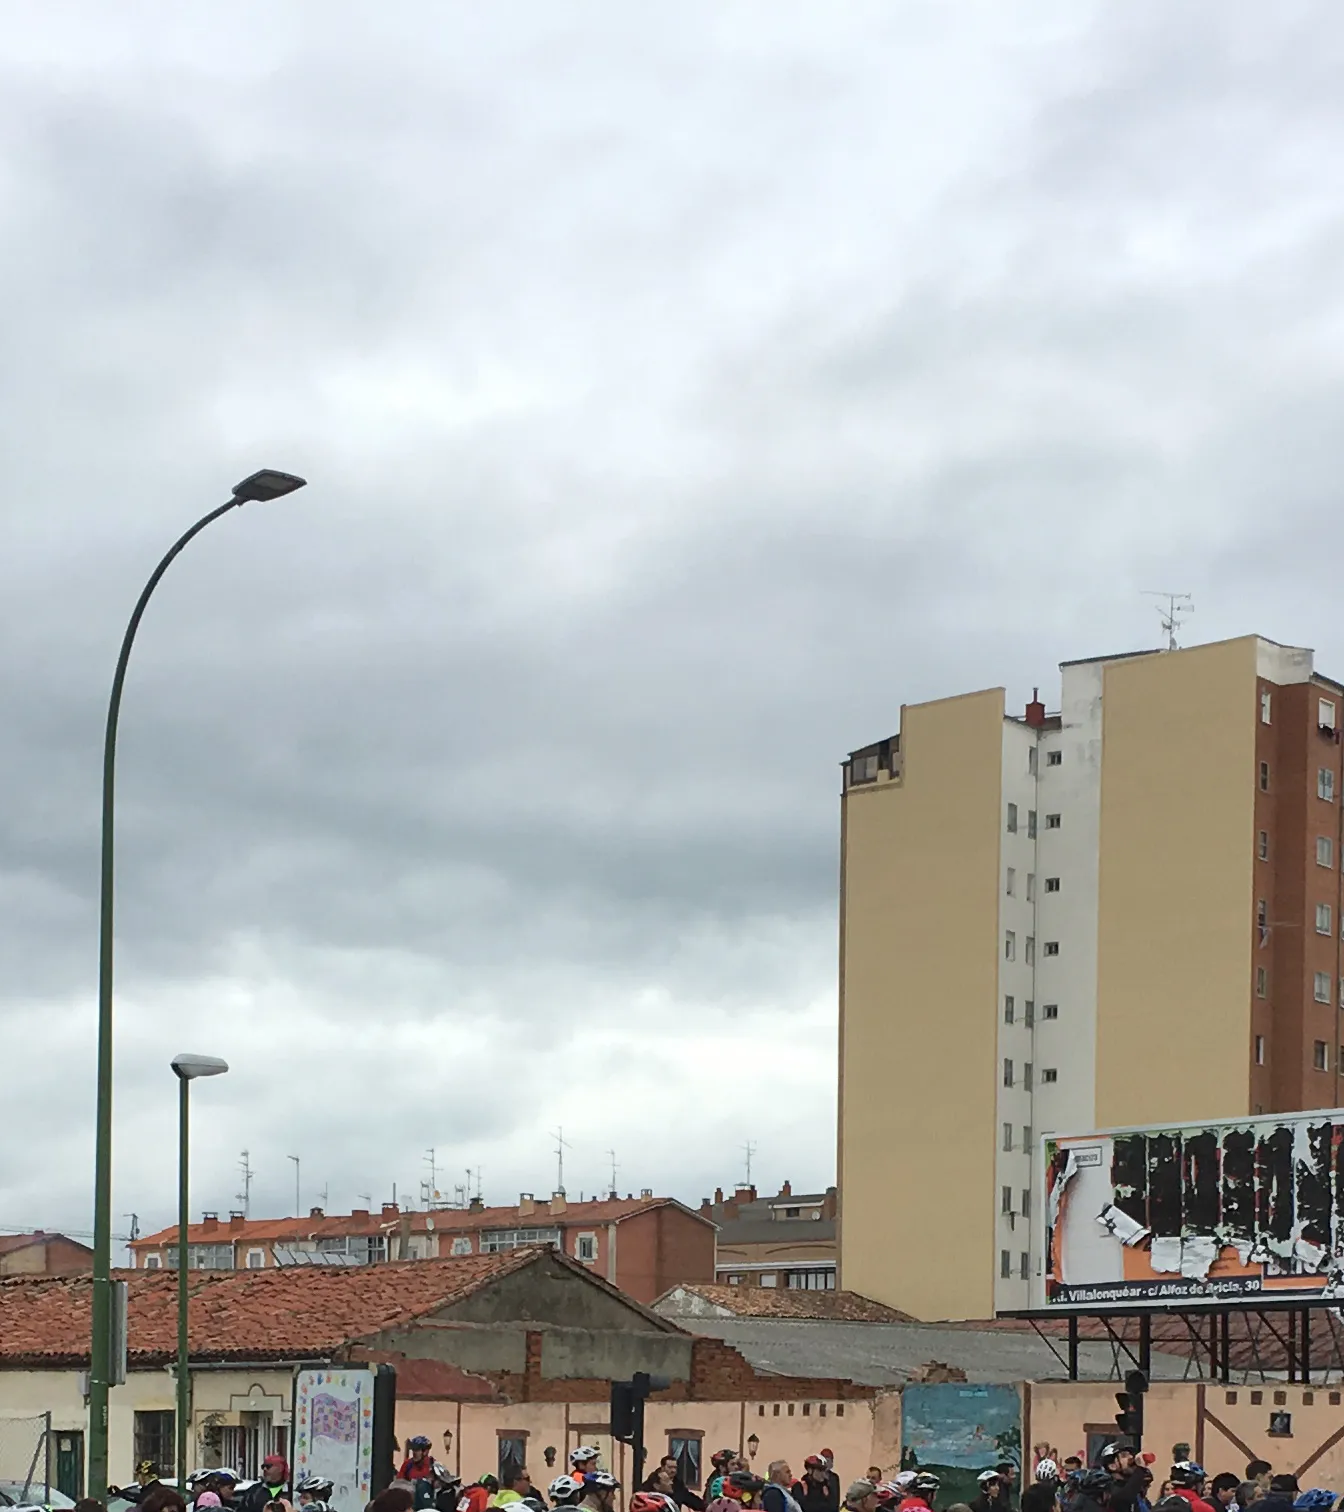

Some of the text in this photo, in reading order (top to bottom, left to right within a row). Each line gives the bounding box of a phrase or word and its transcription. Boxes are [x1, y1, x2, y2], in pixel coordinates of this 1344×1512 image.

[1069, 1283, 1142, 1302] Villalonquéar
[1158, 1284, 1188, 1297] Alfoz
[1190, 1284, 1204, 1295] de
[1245, 1279, 1260, 1291] 30
